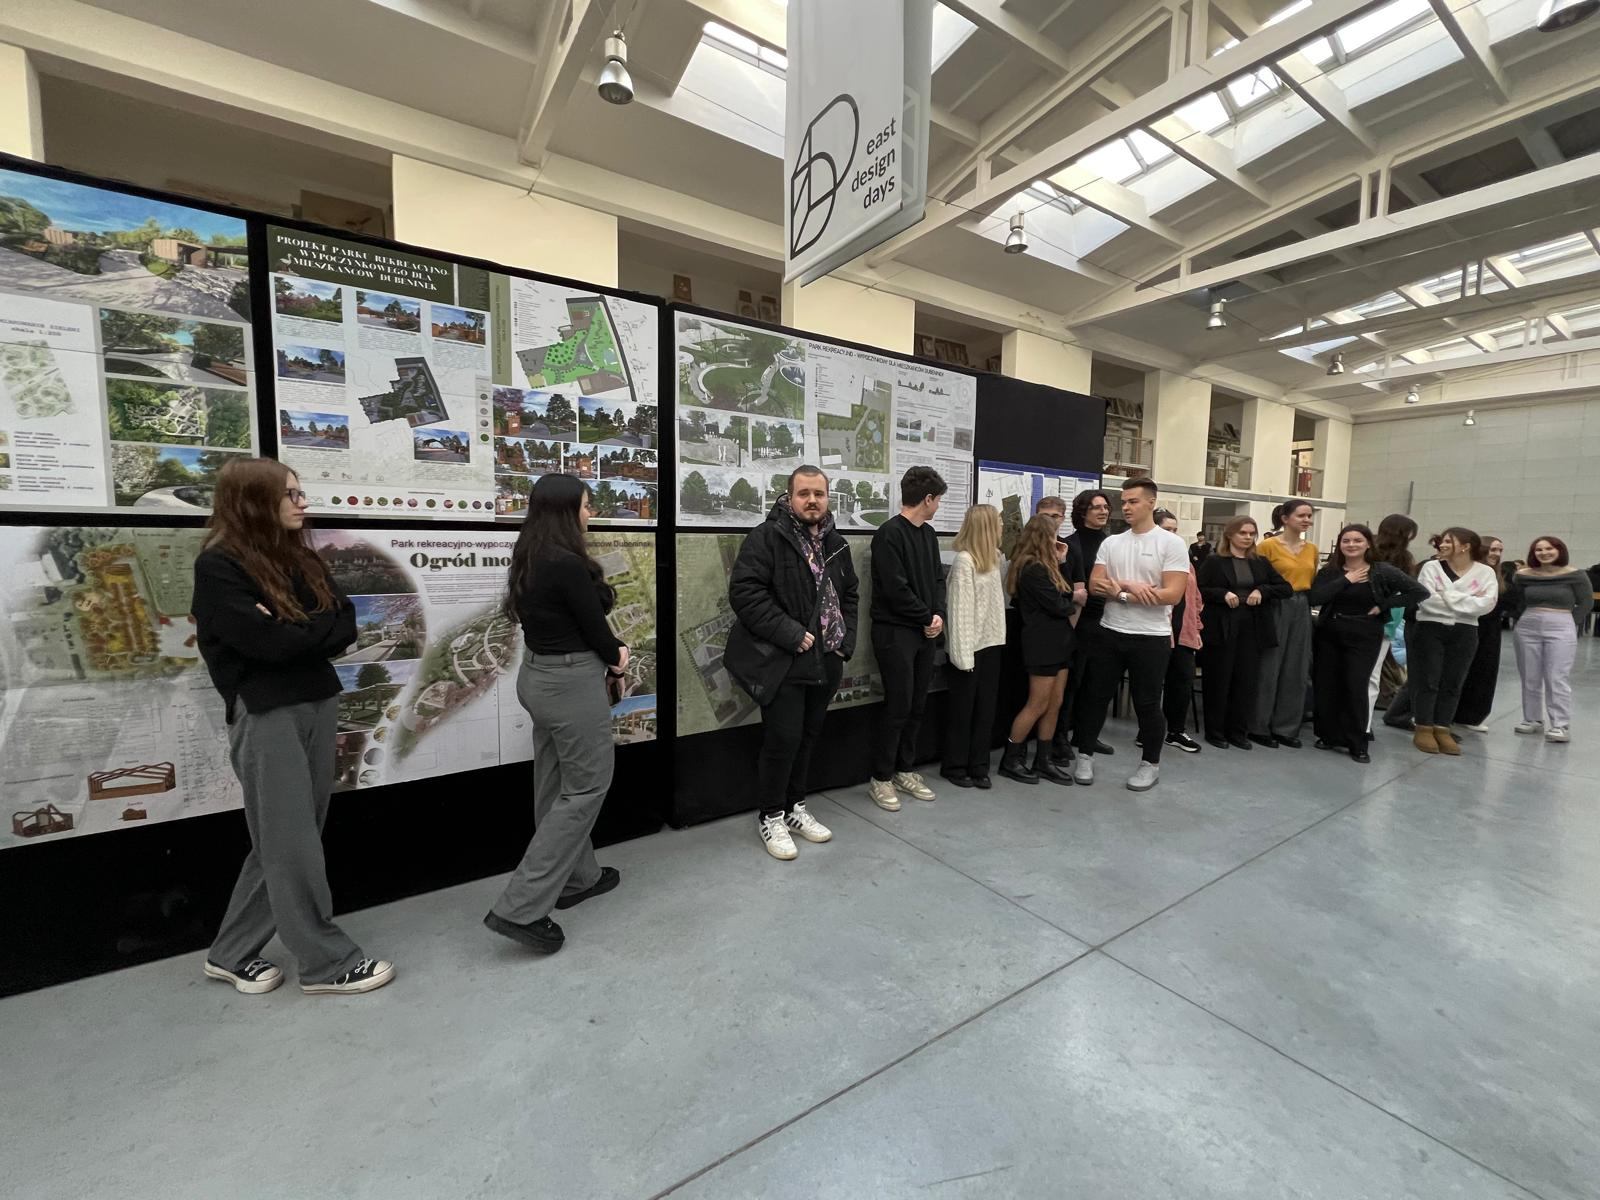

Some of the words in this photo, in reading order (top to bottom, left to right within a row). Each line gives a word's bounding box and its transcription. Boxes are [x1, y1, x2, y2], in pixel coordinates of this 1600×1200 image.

[866, 117, 896, 155] east
[852, 148, 895, 192] design
[863, 176, 895, 209] days
[276, 235, 328, 251] PROJEKT
[332, 246, 368, 260] PARKU
[299, 249, 408, 277] WYPOCZYNKOWEGO
[412, 271, 433, 282] DLA
[391, 540, 414, 548] Park
[416, 540, 517, 549] rekreacyjno-wypoczy
[409, 552, 476, 572] Ogród
[482, 556, 513, 567] mo
